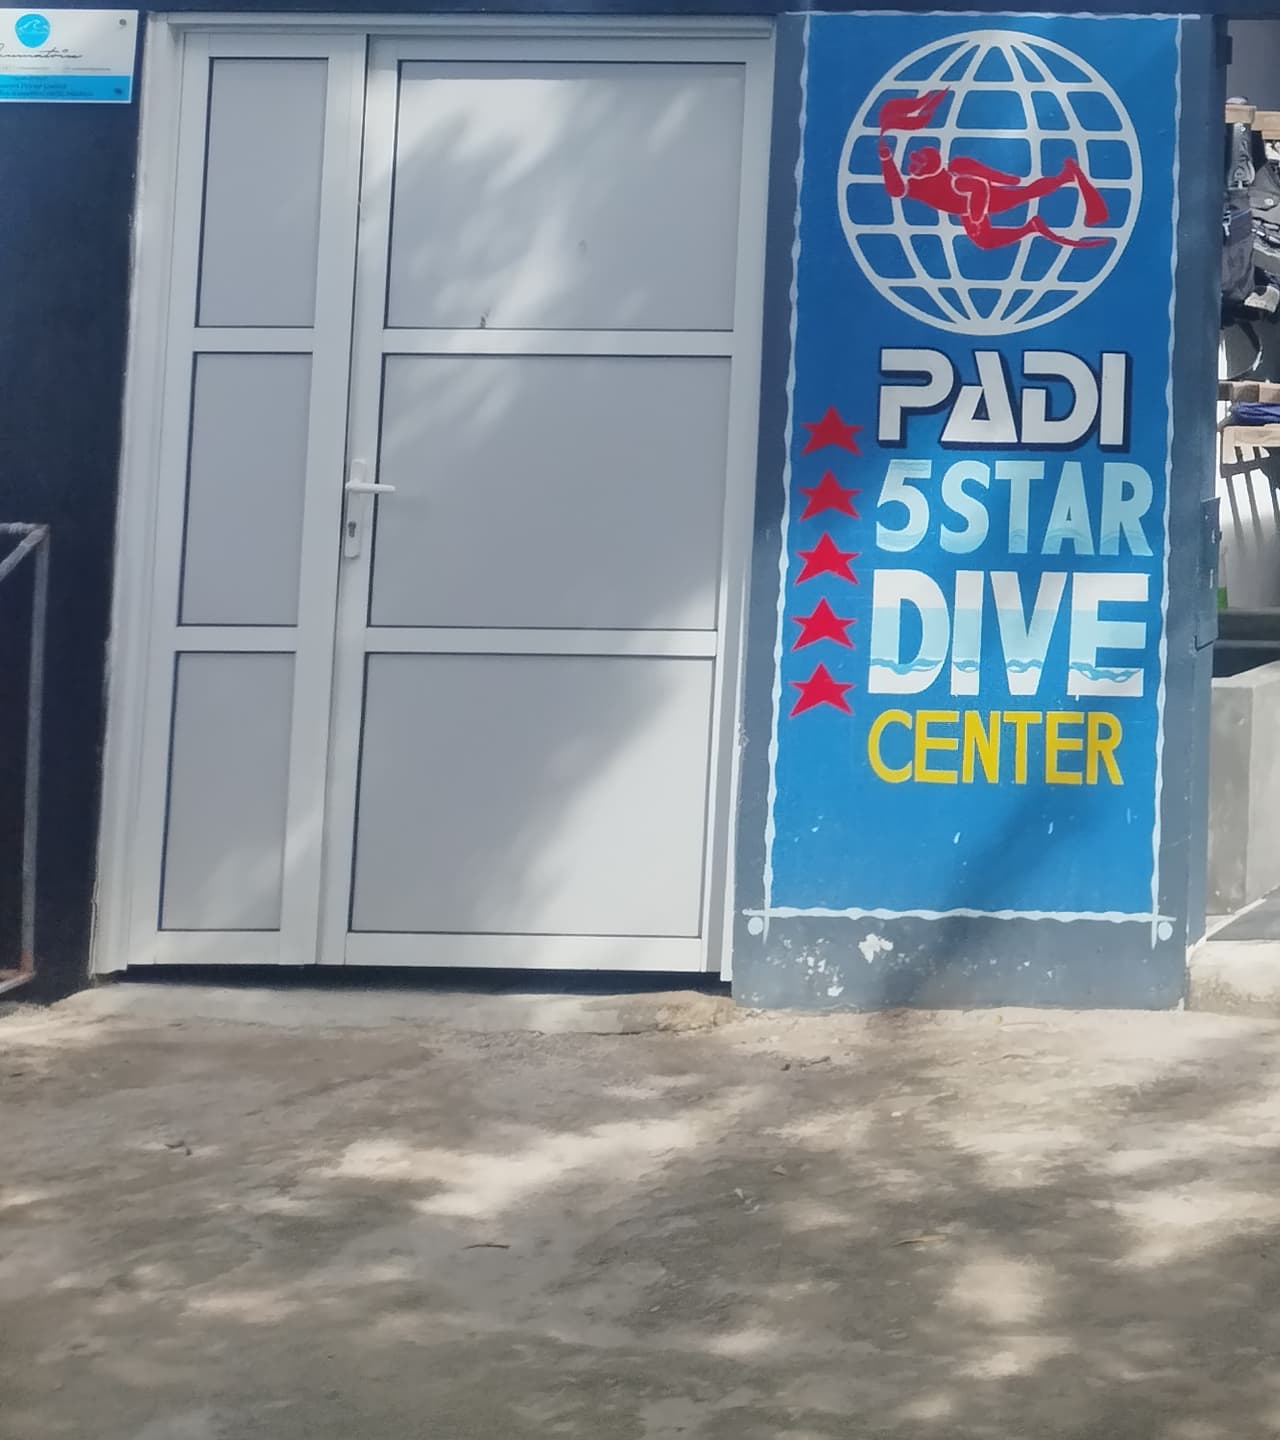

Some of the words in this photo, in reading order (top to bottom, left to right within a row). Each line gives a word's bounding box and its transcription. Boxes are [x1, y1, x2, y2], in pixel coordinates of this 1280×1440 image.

[877, 347, 1131, 453] PADI
[867, 570, 1150, 699] DIVE
[867, 709, 1124, 786] CENTER
